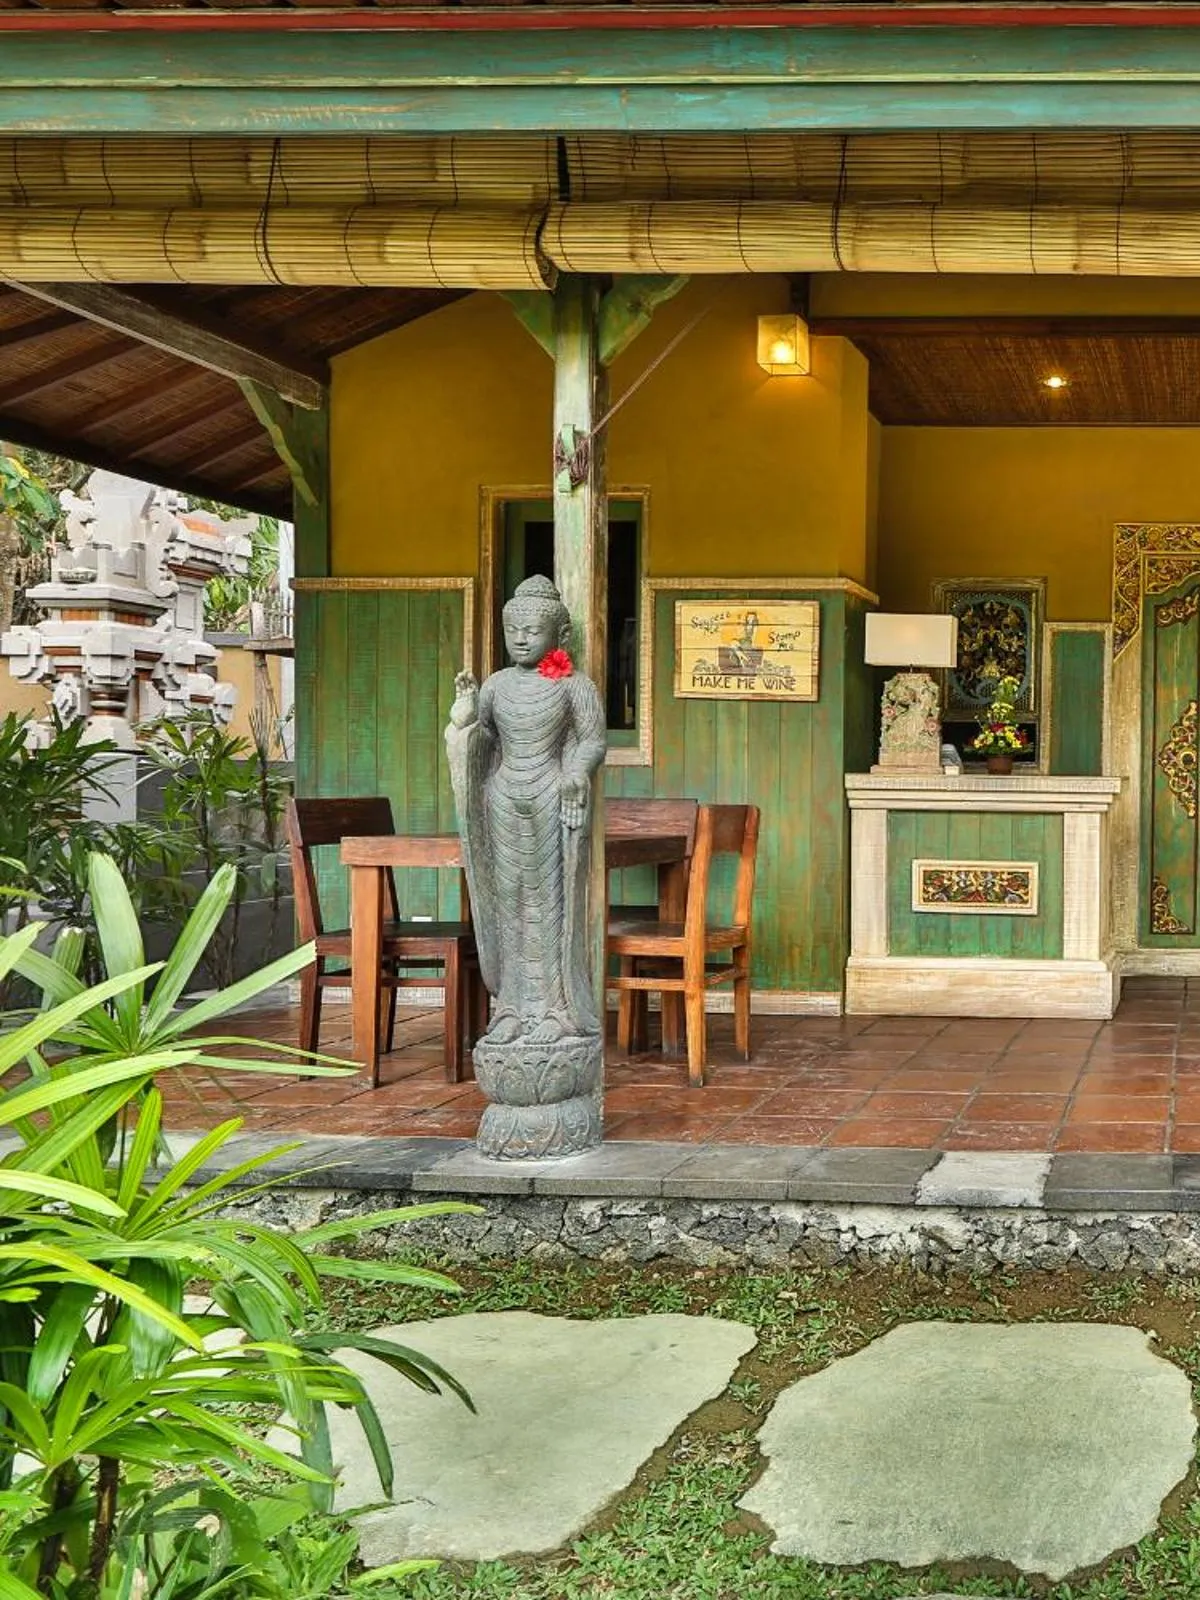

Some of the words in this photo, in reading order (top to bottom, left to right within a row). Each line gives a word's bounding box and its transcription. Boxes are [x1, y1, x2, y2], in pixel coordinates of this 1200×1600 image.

[692, 676, 731, 689] MAKE
[737, 677, 756, 690] ME
[762, 676, 797, 691] WINE
